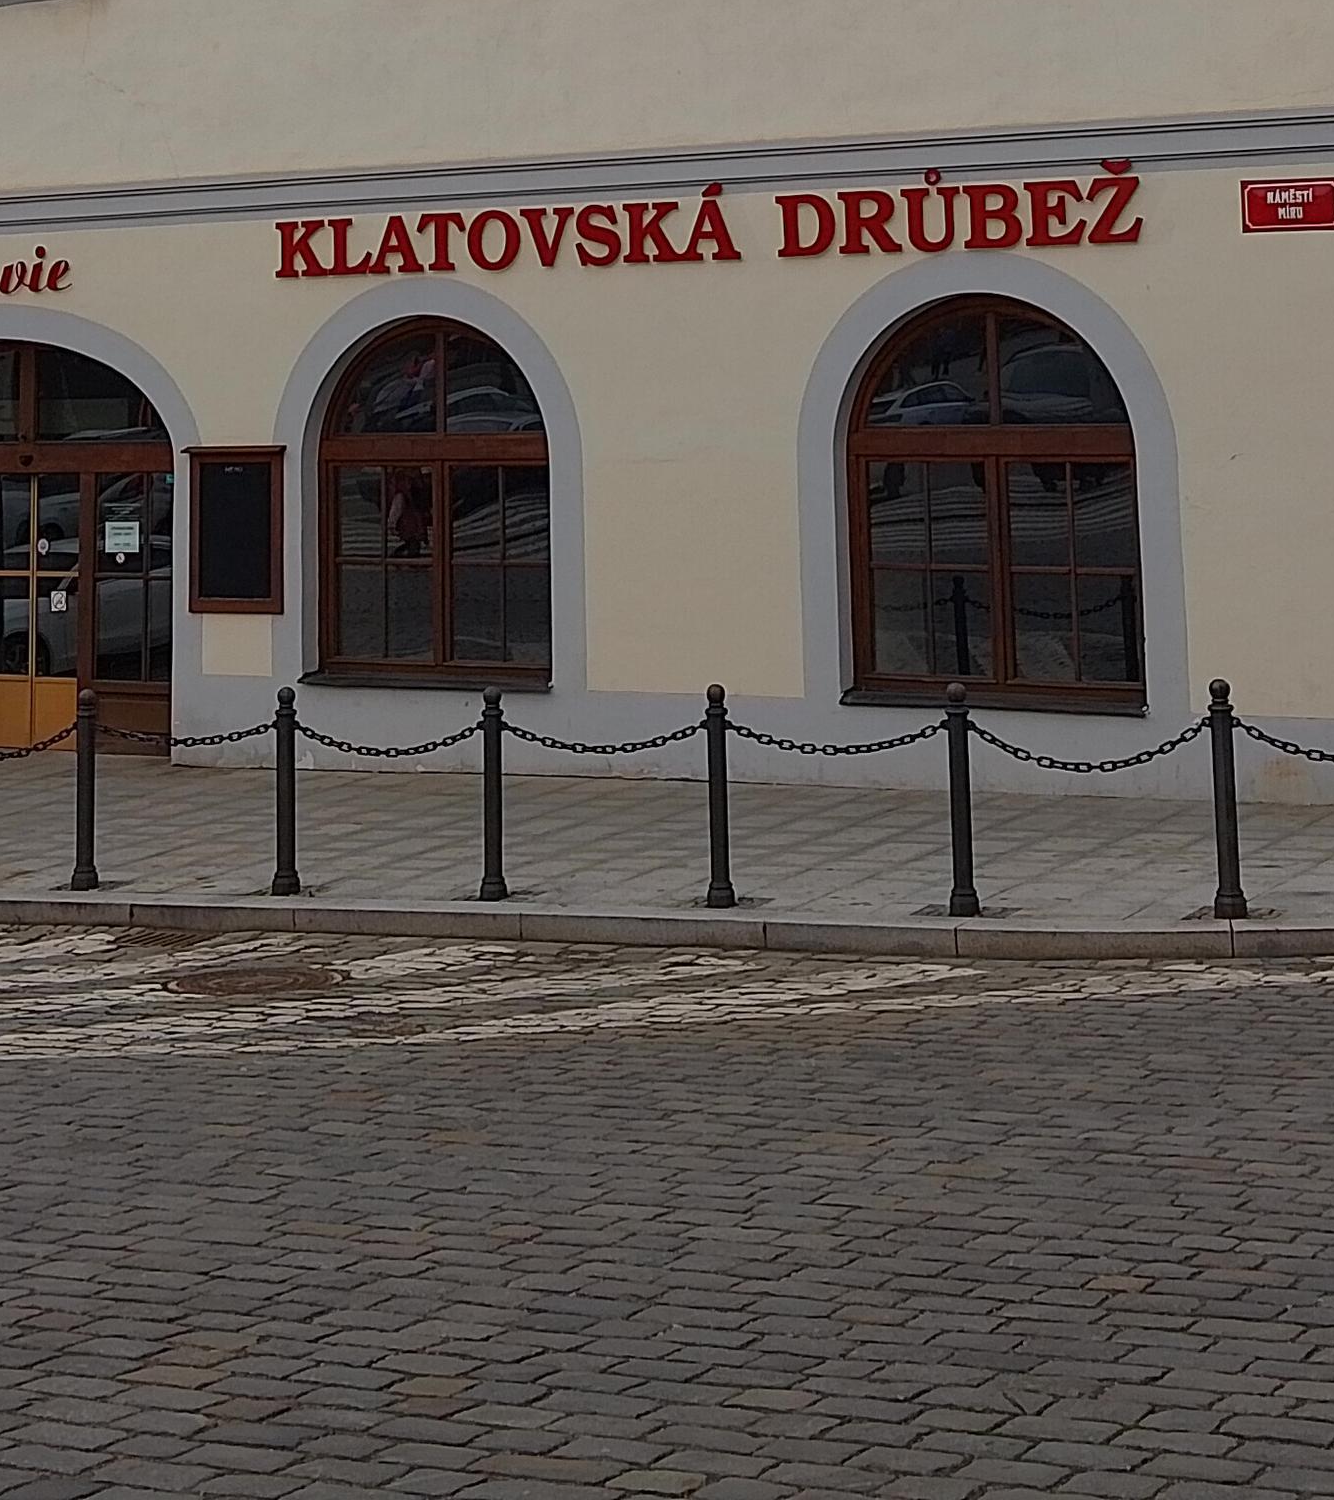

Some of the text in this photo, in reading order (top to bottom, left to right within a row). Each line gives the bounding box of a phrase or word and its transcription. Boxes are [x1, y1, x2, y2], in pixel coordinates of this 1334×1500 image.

[1266, 187, 1313, 204] NÁMĚSTÍ
[275, 158, 1144, 278] KLATOVSKÁ DRŮBEŽ
[1277, 204, 1304, 220] MÍRU
